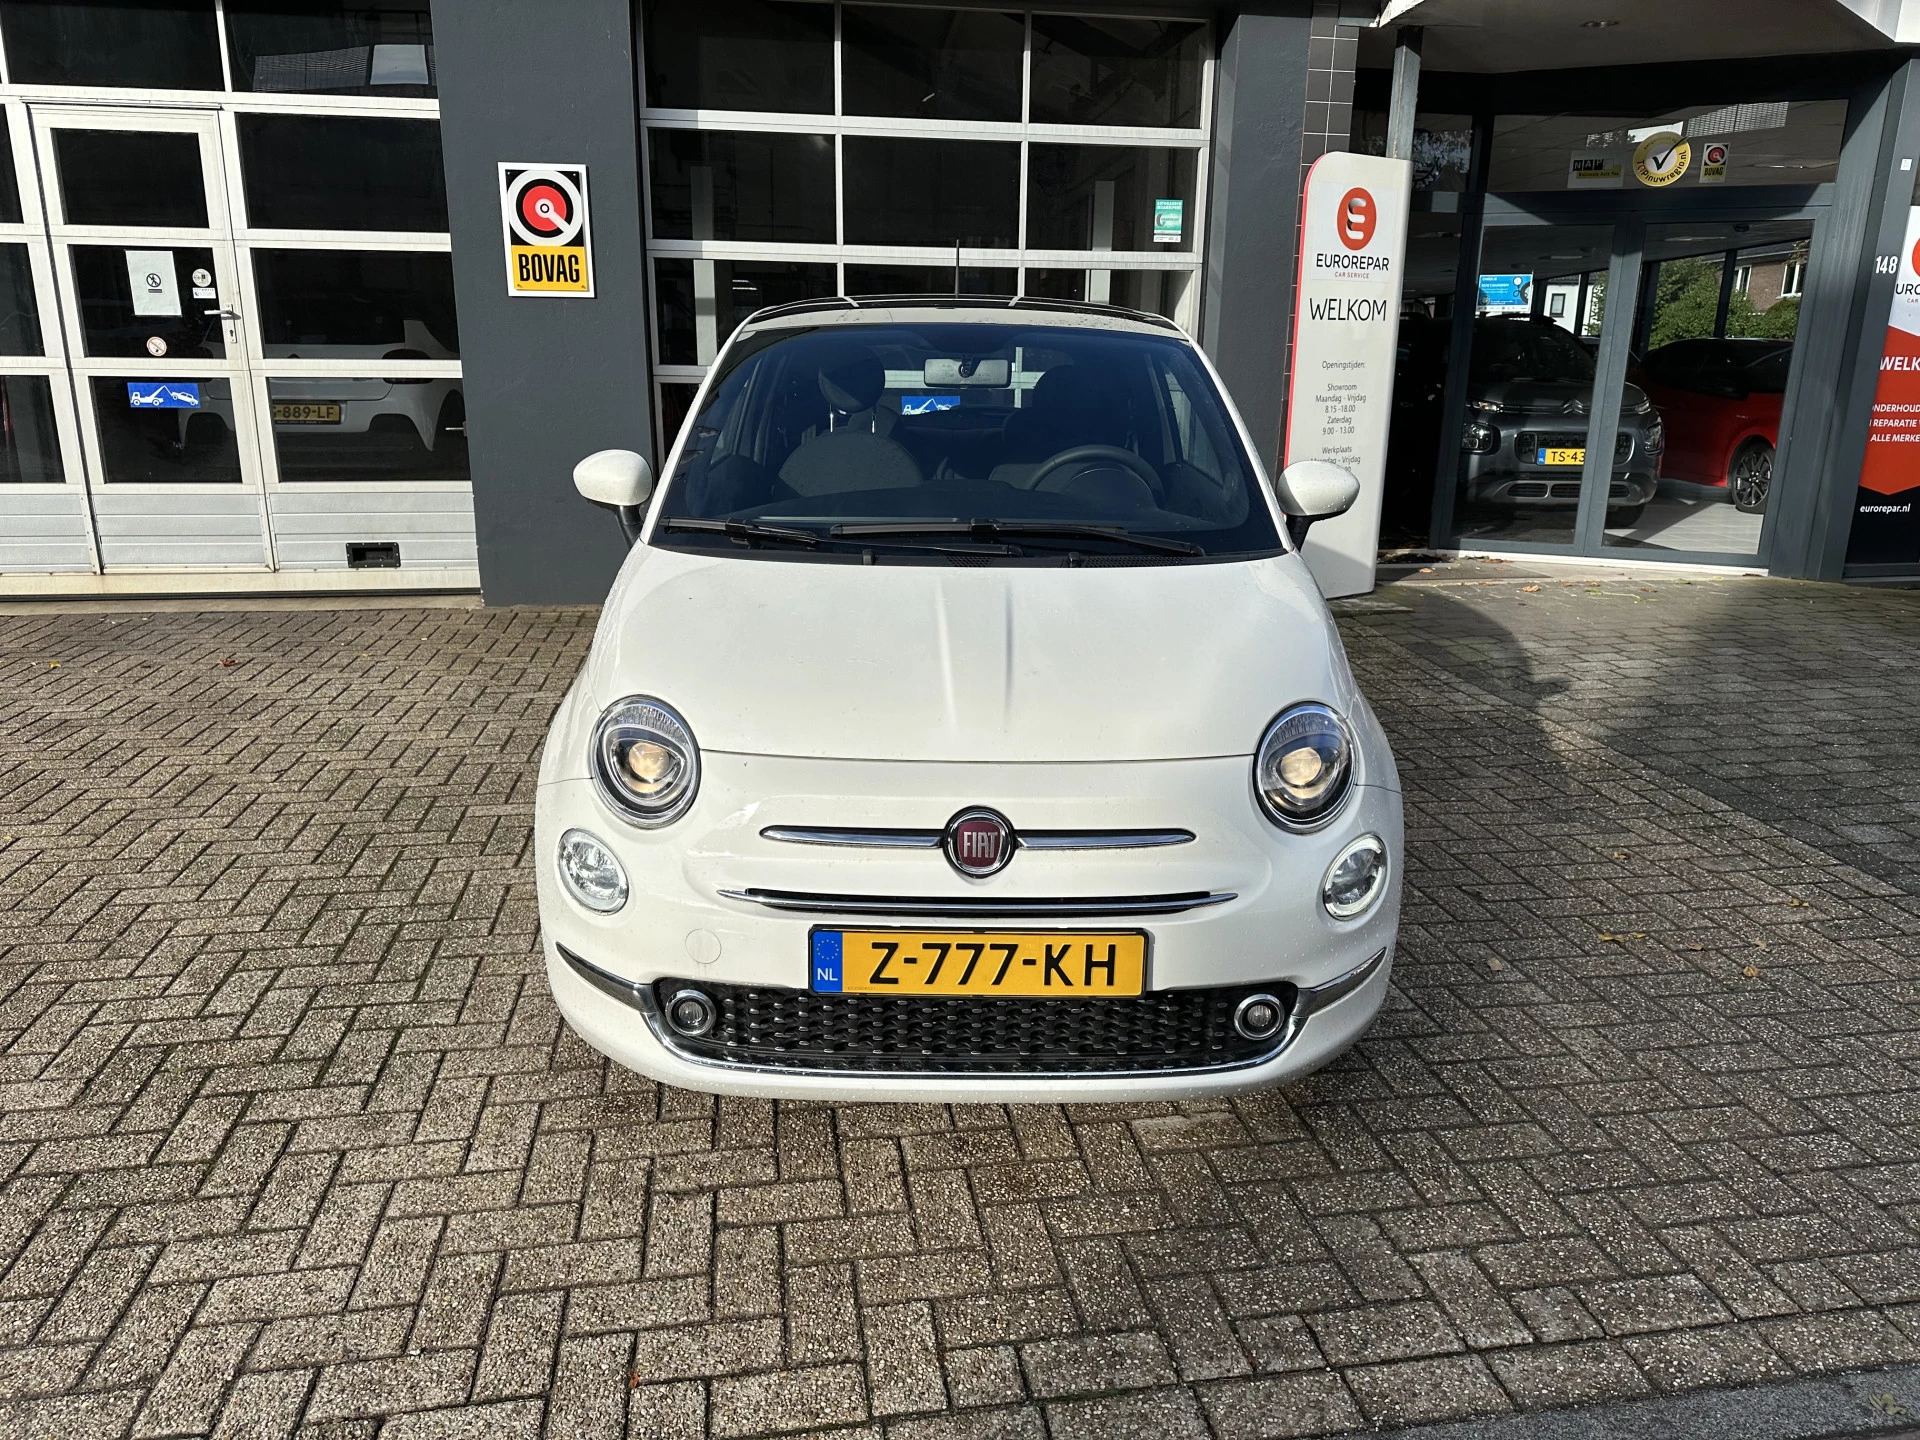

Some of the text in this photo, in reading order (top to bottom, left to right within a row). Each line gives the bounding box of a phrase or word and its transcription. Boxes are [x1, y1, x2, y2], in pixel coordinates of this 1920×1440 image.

[1574, 159, 1602, 169] NAP
[1704, 167, 1723, 176] BOVAG
[1316, 253, 1390, 271] EUROREPAR
[1875, 255, 1899, 274] 148
[518, 253, 580, 283] BOVAG
[1309, 297, 1387, 321] WELKOM
[1327, 383, 1358, 391] Showroom
[1315, 394, 1342, 404] Maandag
[1347, 394, 1367, 403] Vrijdag
[1327, 416, 1352, 425] Zaterdag
[1873, 418, 1917, 428] REPARATIE
[1322, 427, 1335, 435] 9.00
[1340, 426, 1355, 434] 13.00
[1870, 433, 1891, 442] ALLE
[1322, 446, 1352, 456] Werkplaats
[1341, 455, 1361, 465] Vrijdag
[1859, 502, 1911, 515] eurorepar.nl
[963, 831, 999, 859] FIAT
[817, 942, 1117, 987] NL Z-777-KH
